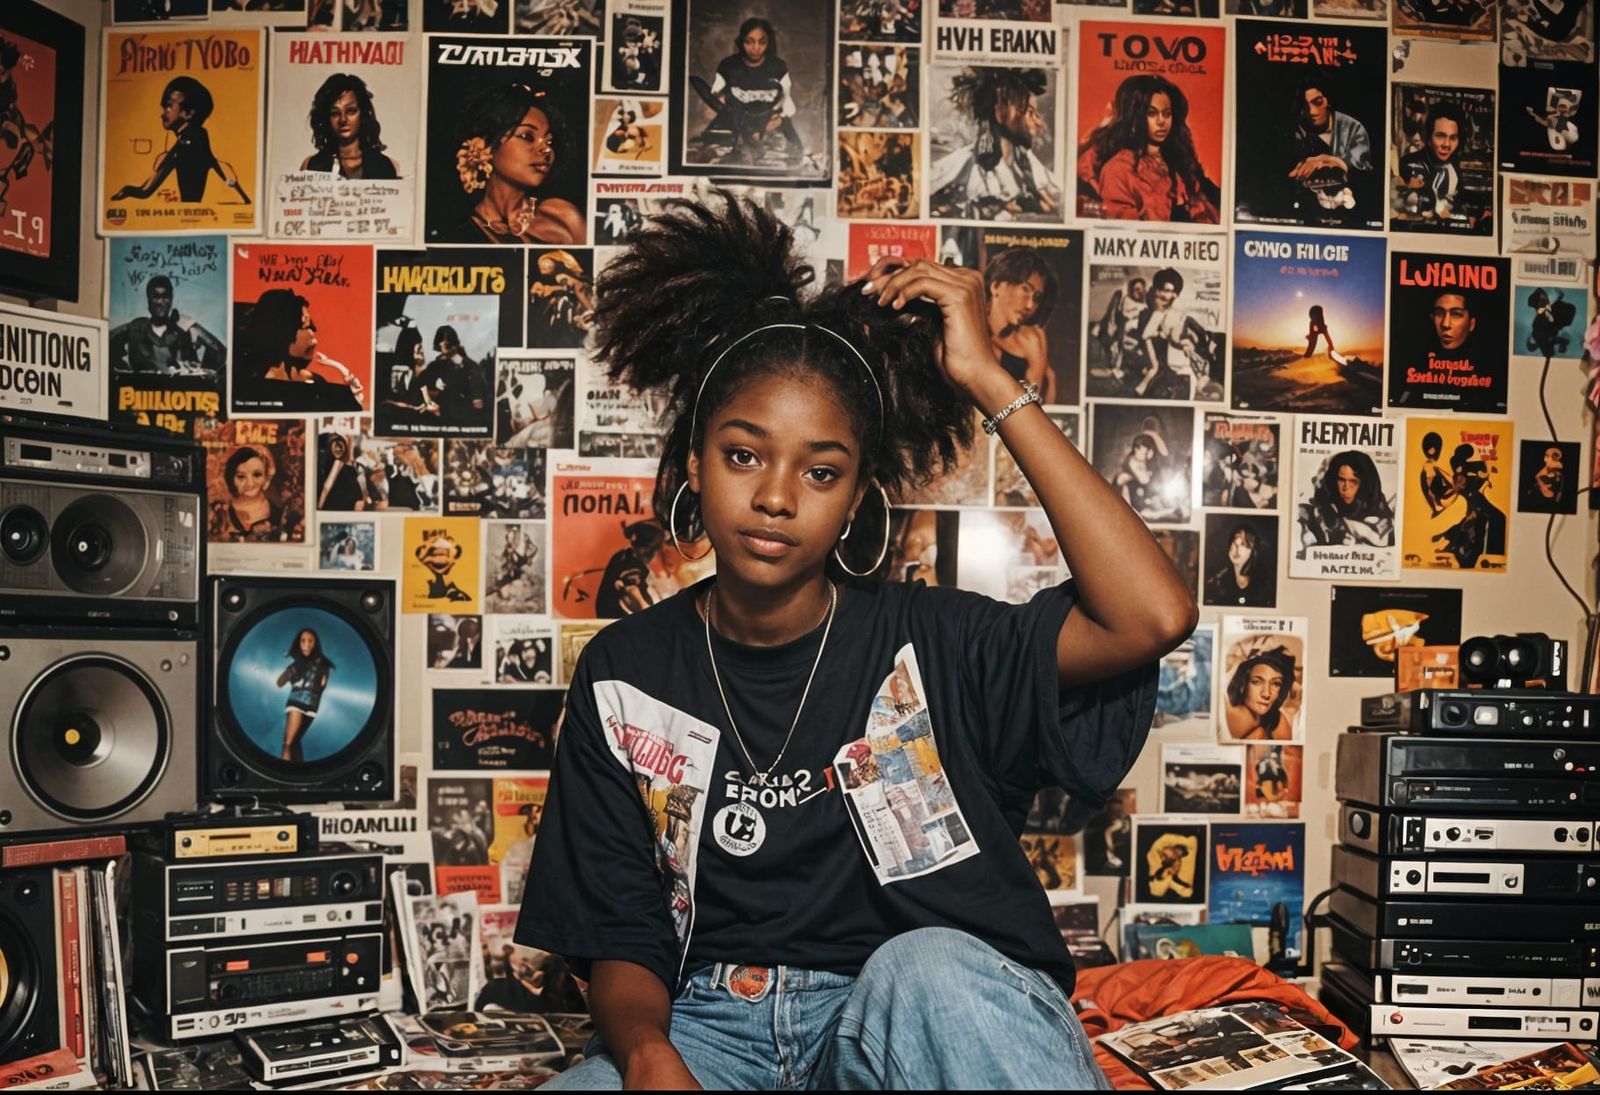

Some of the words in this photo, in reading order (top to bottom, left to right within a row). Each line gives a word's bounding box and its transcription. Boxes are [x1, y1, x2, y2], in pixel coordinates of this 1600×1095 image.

[937, 26, 983, 51] HVH
[990, 28, 1056, 55] ERAKN
[1097, 33, 1207, 63] TOVO
